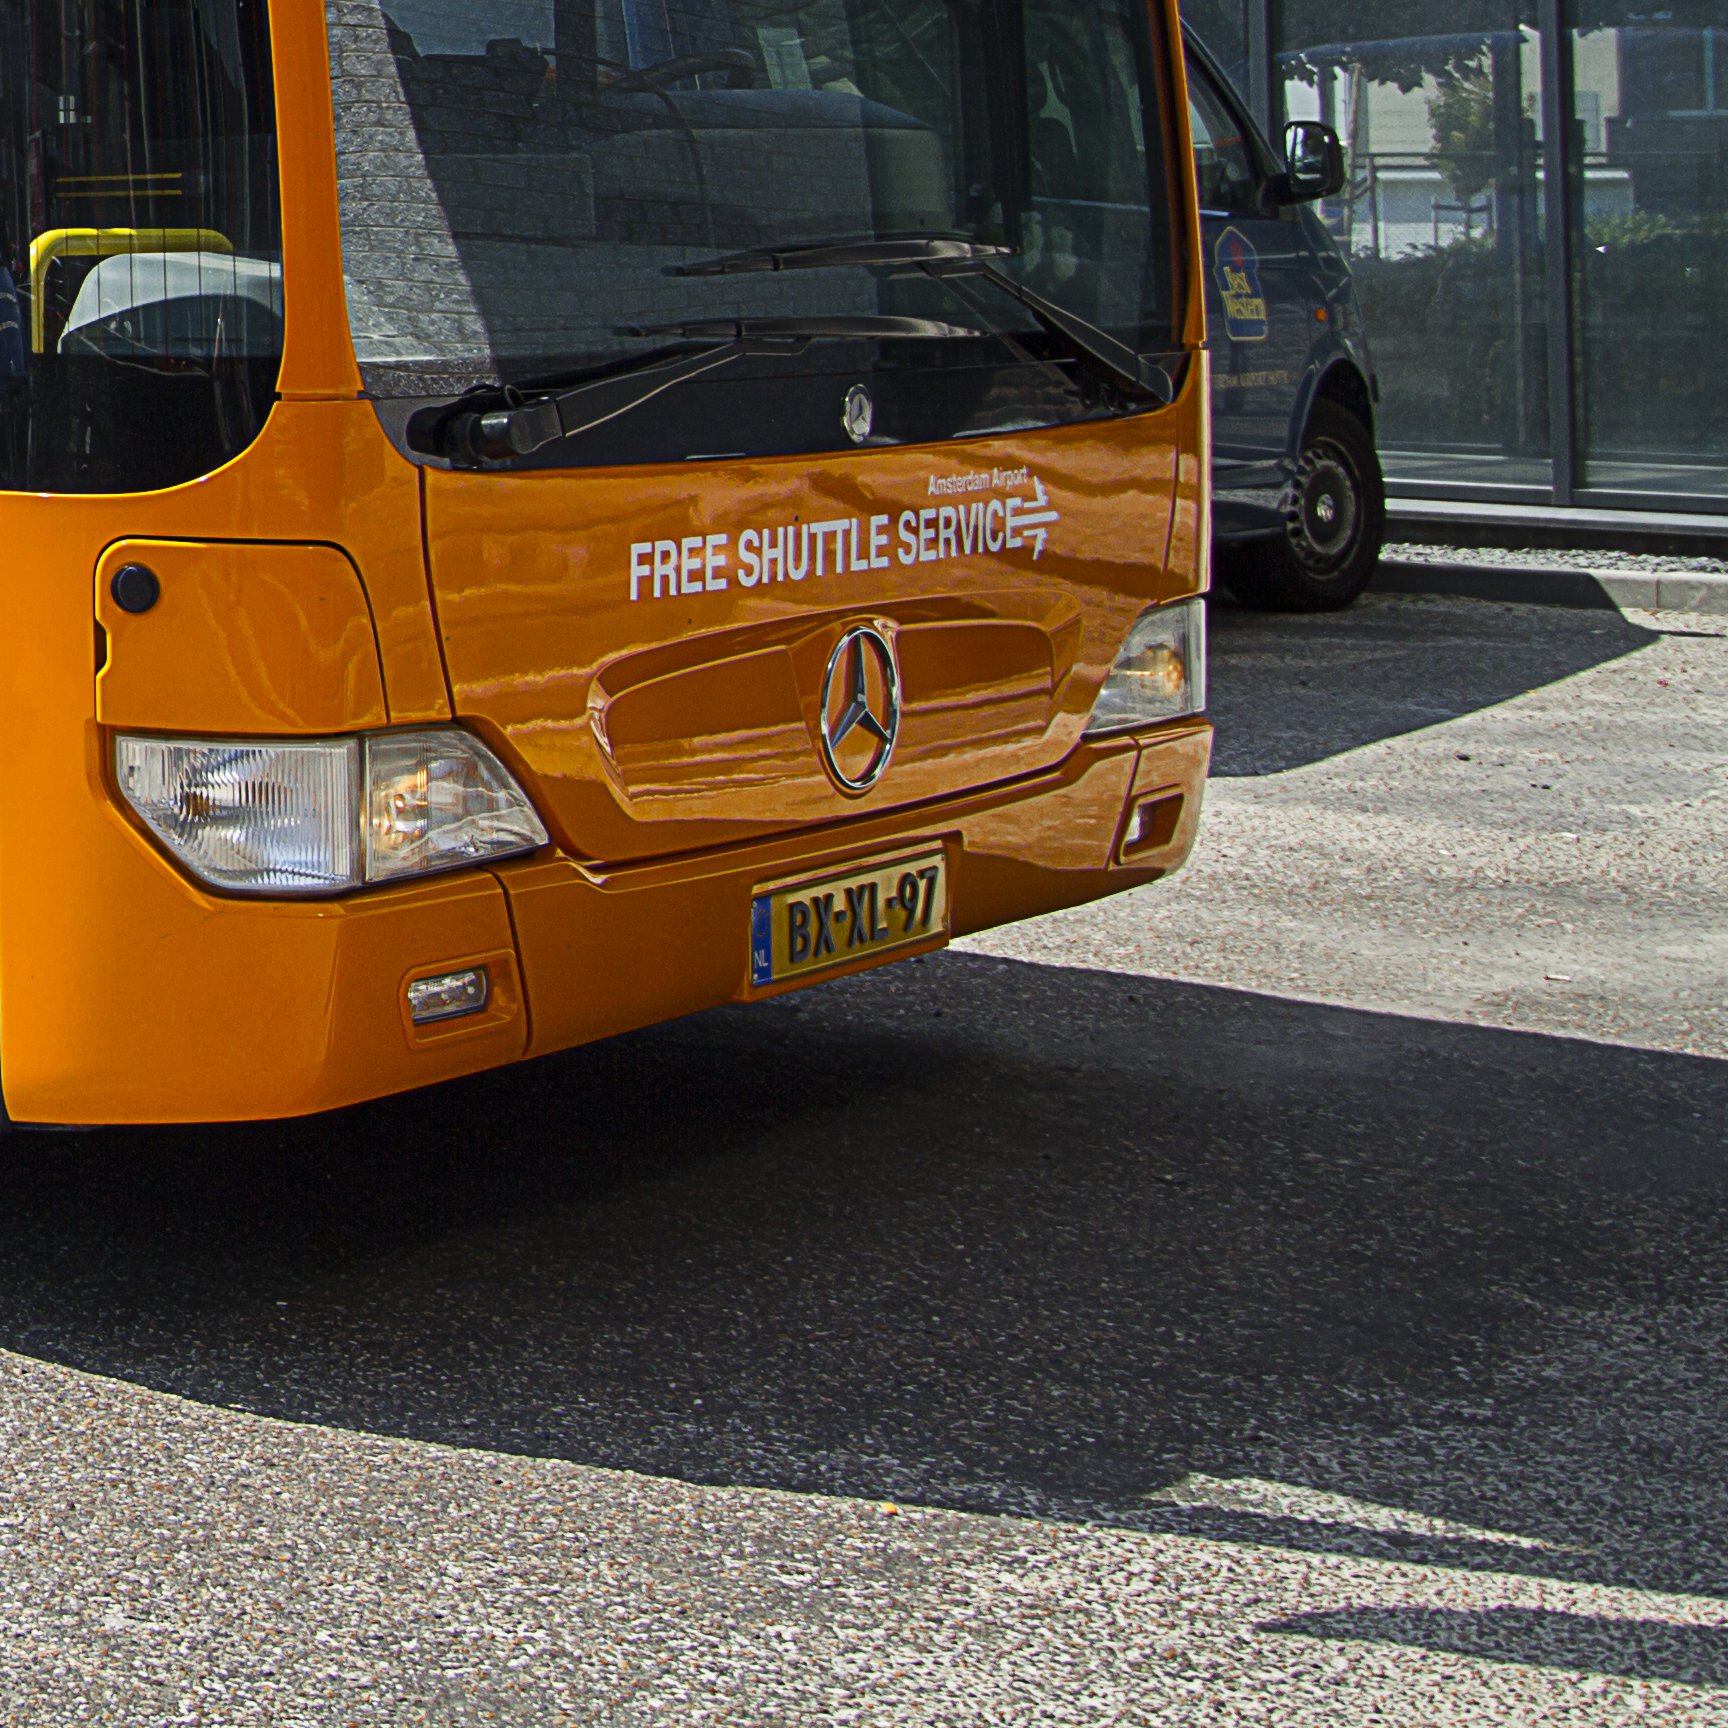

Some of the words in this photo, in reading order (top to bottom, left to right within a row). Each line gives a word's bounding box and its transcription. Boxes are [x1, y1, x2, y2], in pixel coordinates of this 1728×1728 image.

[928, 471, 991, 496] Amsterdam
[991, 465, 1029, 491] Airport
[629, 533, 729, 601] FREE
[737, 514, 890, 588] SHUTTLE
[896, 496, 1025, 566] SERVICE
[786, 865, 939, 965] BX-XL-97
[753, 951, 769, 969] NL
